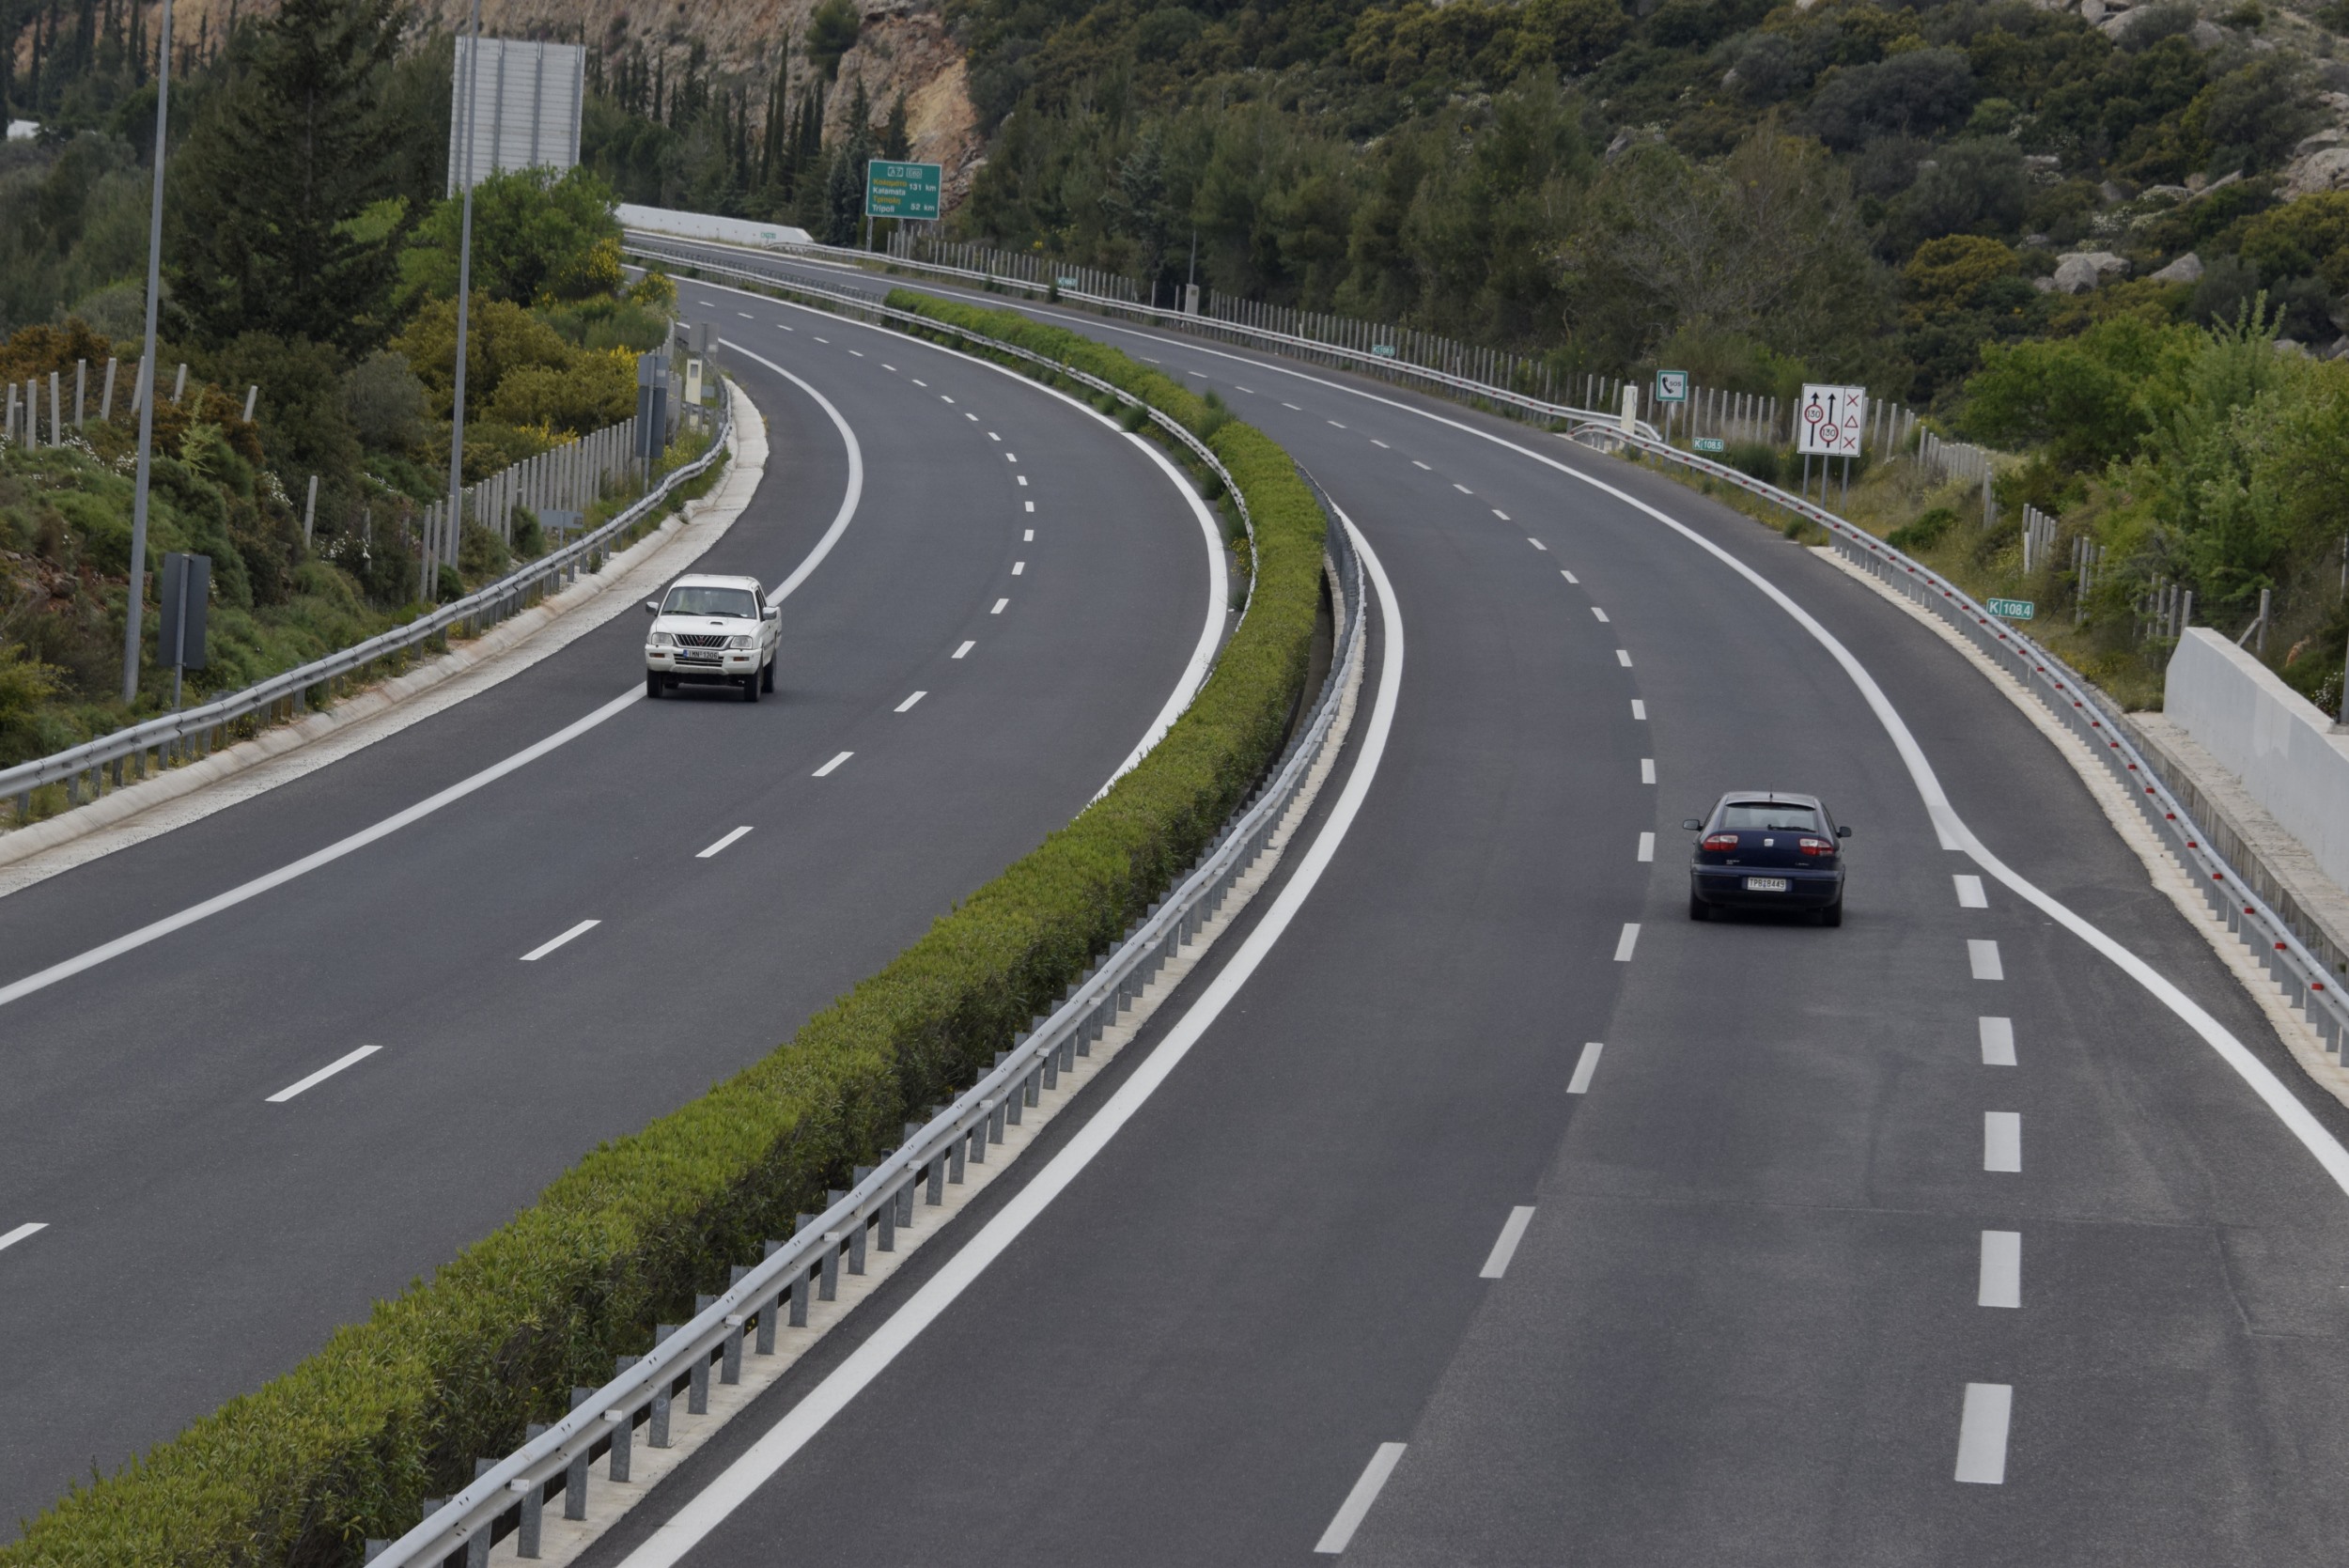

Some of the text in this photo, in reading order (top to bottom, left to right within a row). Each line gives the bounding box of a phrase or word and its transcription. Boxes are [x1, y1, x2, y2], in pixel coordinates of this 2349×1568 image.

[873, 187, 906, 195] Kalamata
[872, 204, 895, 213] Tripoli
[910, 203, 921, 211] 52
[1807, 410, 1820, 418] 130
[1822, 428, 1836, 438] 130
[1694, 440, 1701, 449] K
[1989, 601, 1999, 613] K
